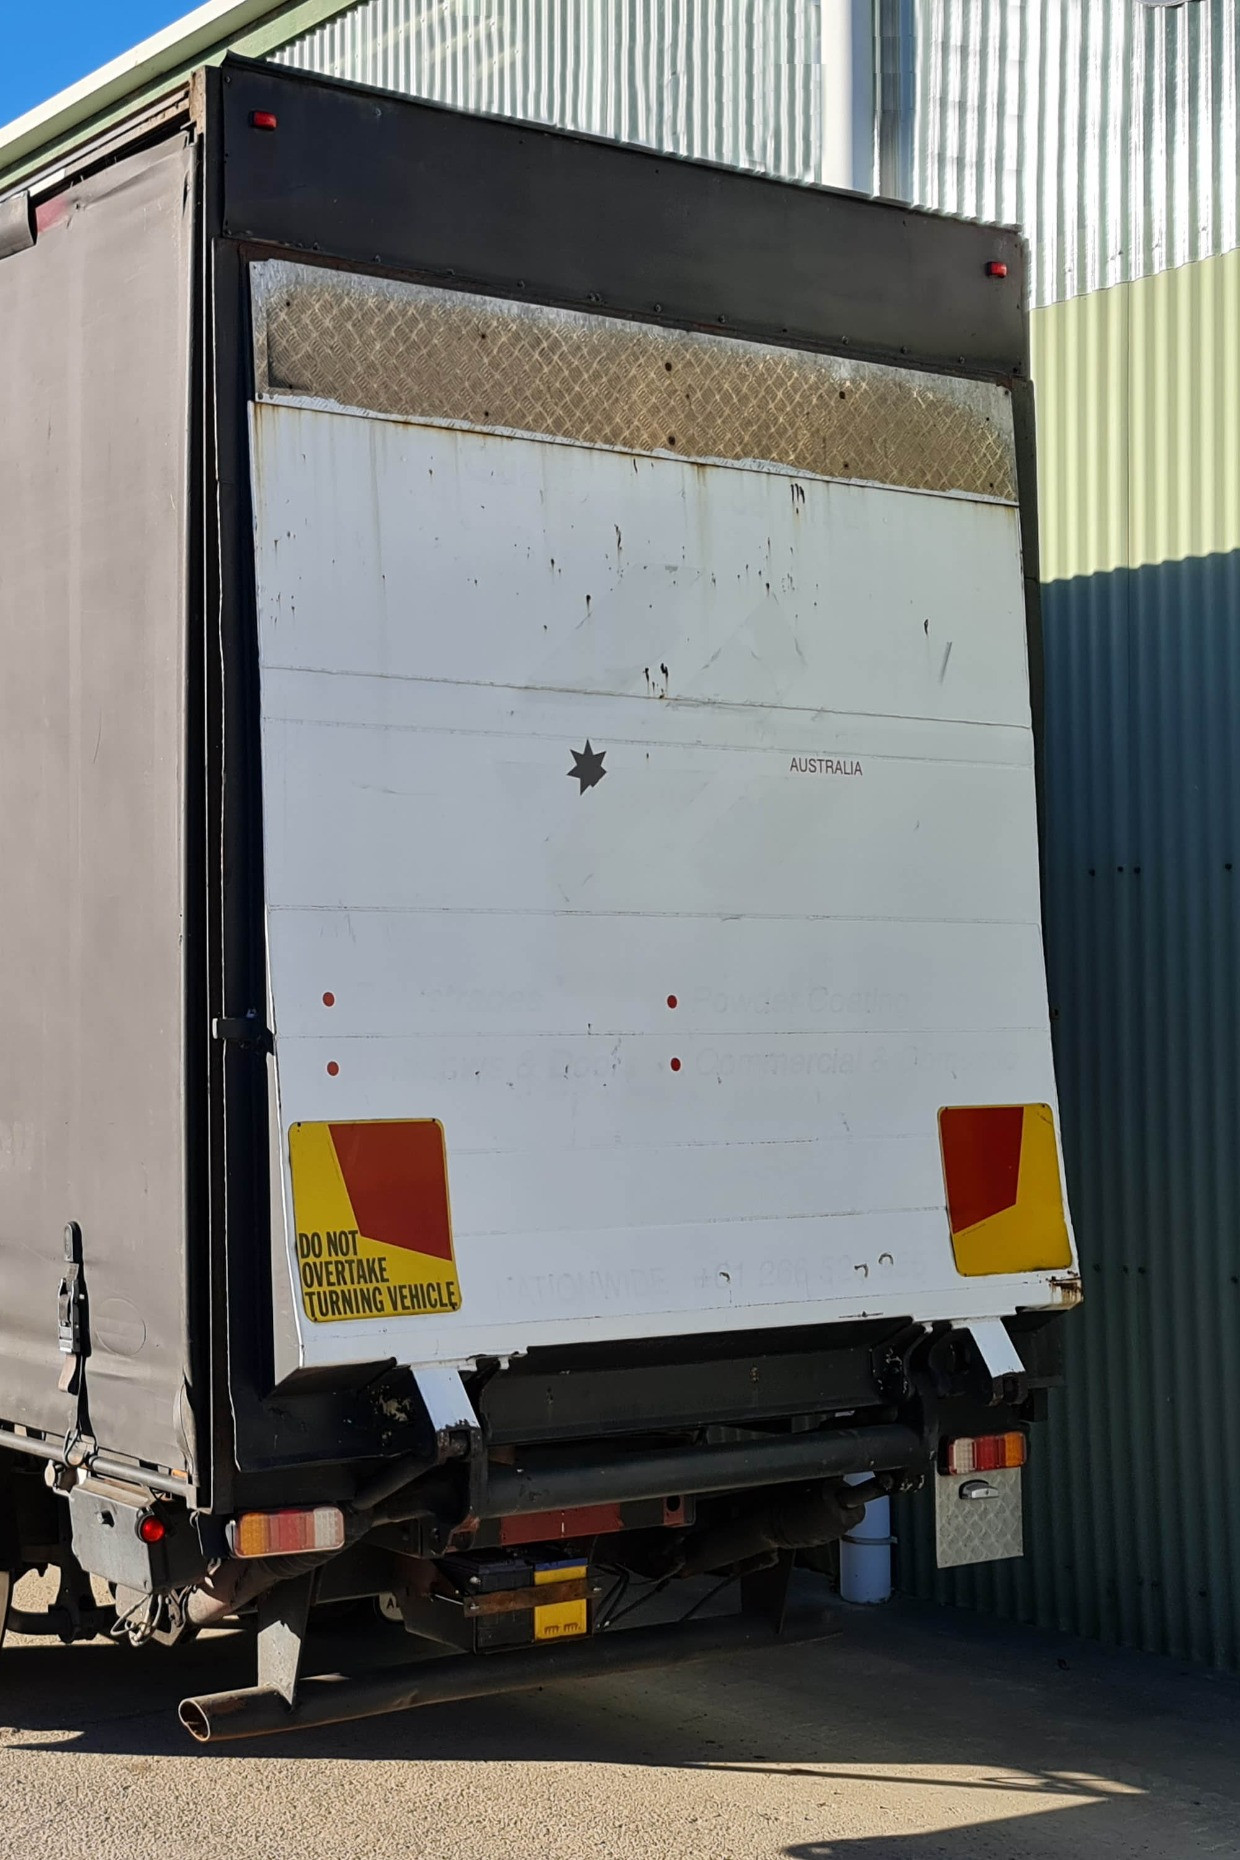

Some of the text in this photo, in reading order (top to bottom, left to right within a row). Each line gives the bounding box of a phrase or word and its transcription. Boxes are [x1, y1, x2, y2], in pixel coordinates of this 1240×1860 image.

[789, 756, 864, 777] AUSTRALIA
[298, 1229, 359, 1259] DO NOT
[301, 1257, 390, 1289] OVERTAKE
[304, 1280, 458, 1318] TURNING VEHICLE
